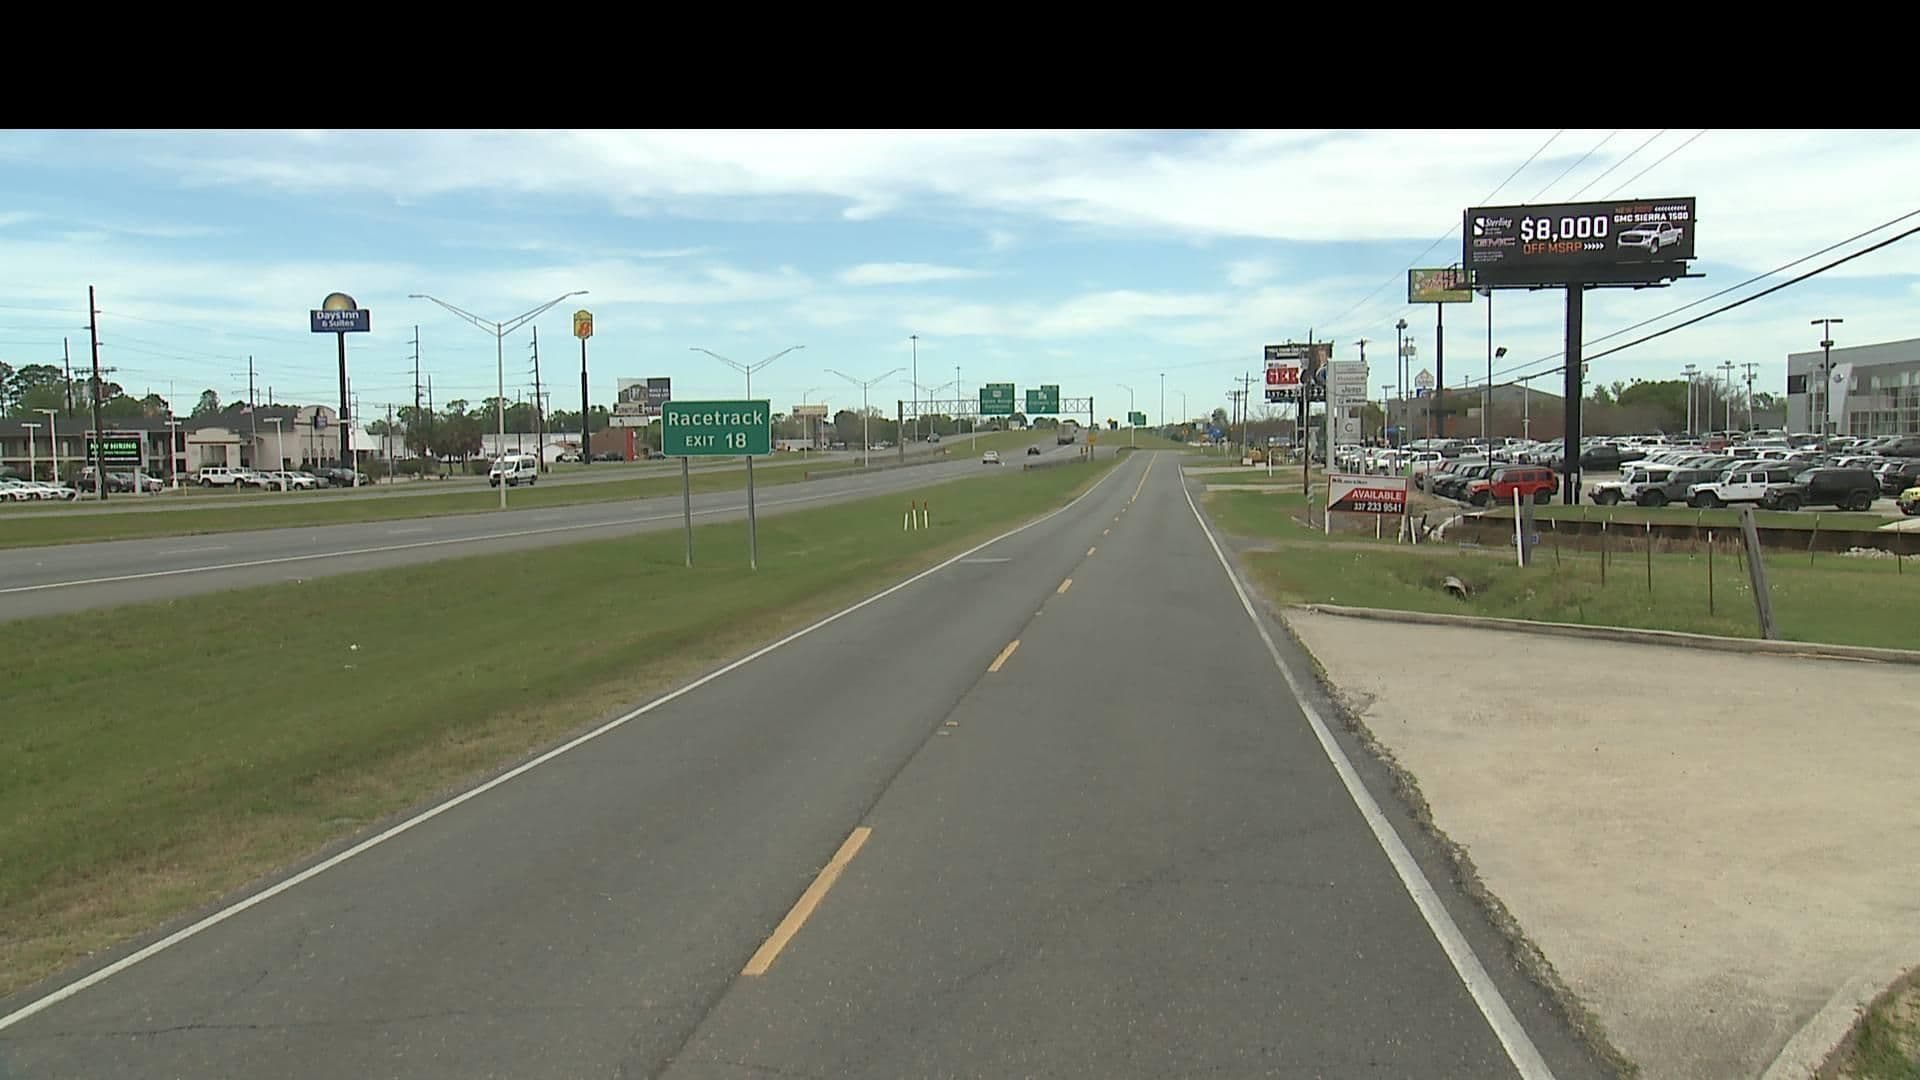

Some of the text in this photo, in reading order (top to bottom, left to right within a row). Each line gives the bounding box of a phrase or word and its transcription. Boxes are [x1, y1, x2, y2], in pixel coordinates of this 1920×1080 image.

[1486, 217, 1512, 229] Sterling
[1614, 211, 1689, 223] GMC SIERRA 1500
[1520, 216, 1608, 243] $8,000
[1473, 237, 1516, 248] GMC
[1523, 241, 1583, 255] OFF MSRP
[316, 311, 360, 321] Days Inn
[329, 319, 355, 328] Suites
[668, 410, 763, 427] Racetrack
[685, 432, 747, 449] EXIT 18
[1351, 489, 1402, 501] AVAILABLE
[1353, 502, 1402, 513] 337 233 9541
